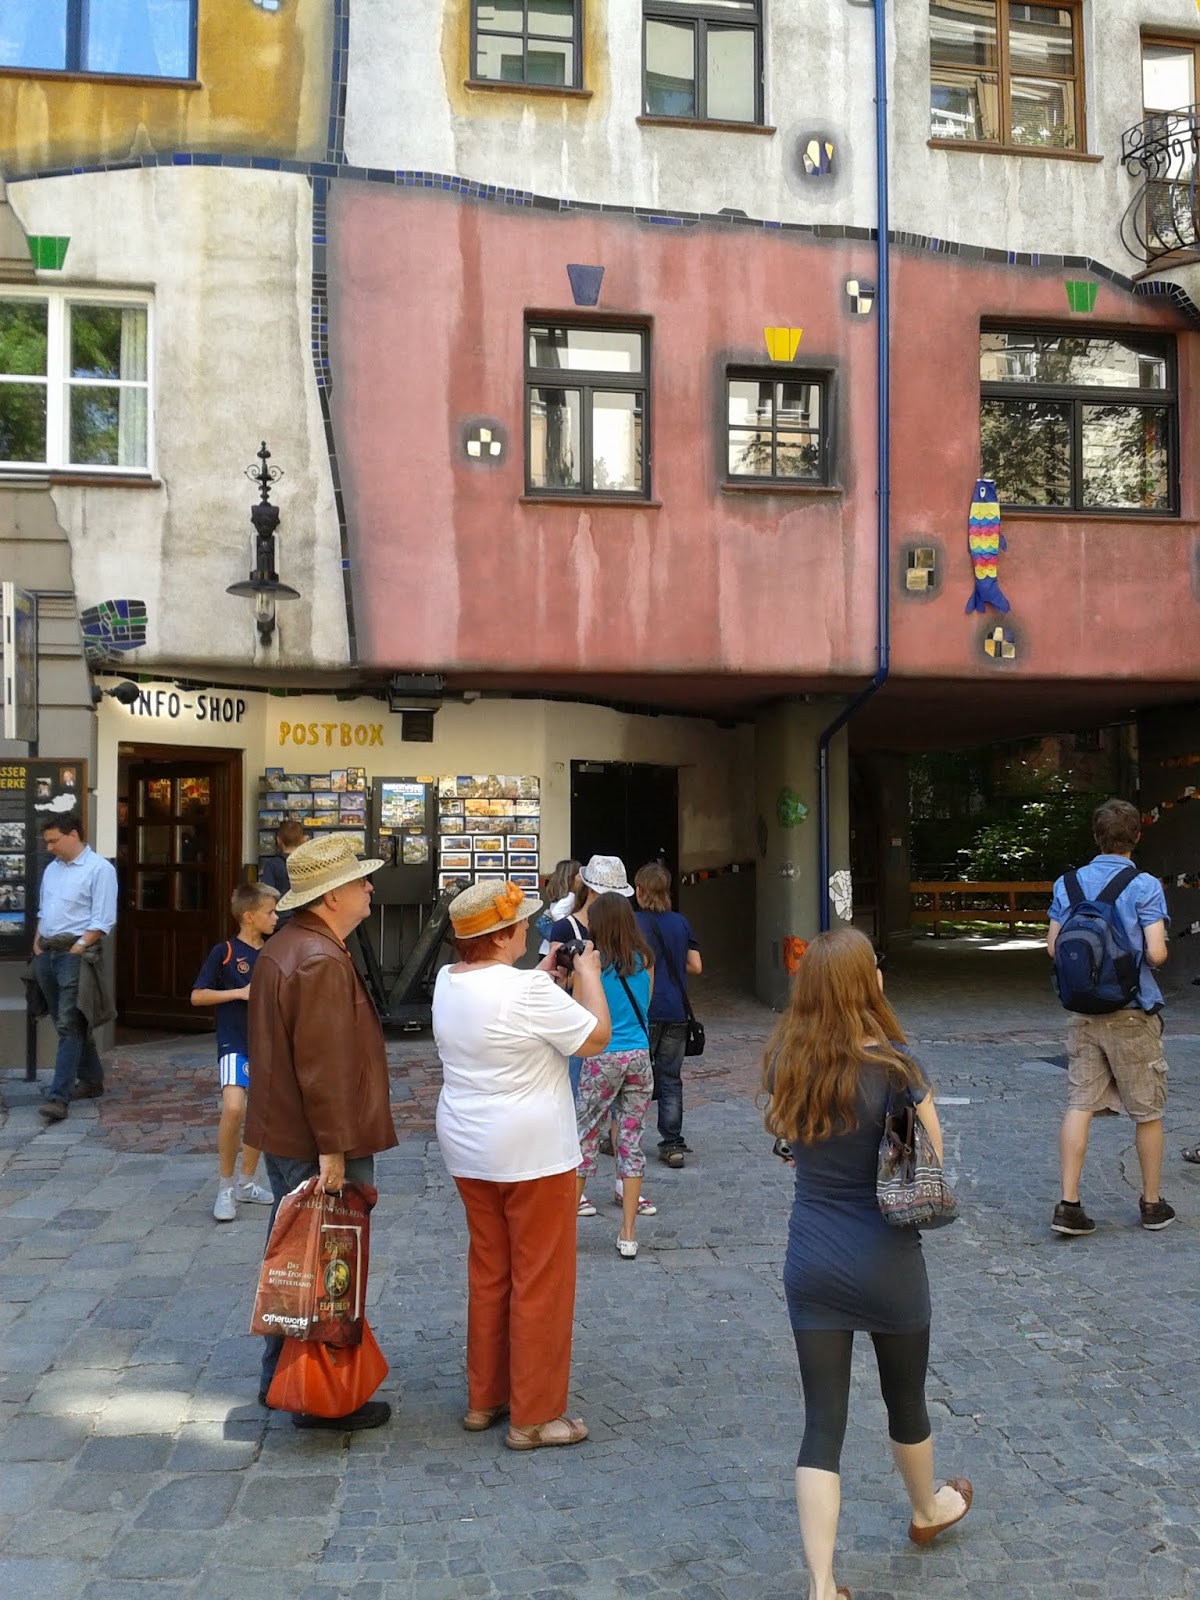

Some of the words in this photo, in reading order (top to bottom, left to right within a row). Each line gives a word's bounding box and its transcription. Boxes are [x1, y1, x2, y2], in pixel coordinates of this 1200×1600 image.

[129, 690, 246, 723] INFO-SHOP
[279, 721, 384, 747] POSTBOX
[0, 766, 26, 777] SSER
[0, 778, 26, 789] ERKE
